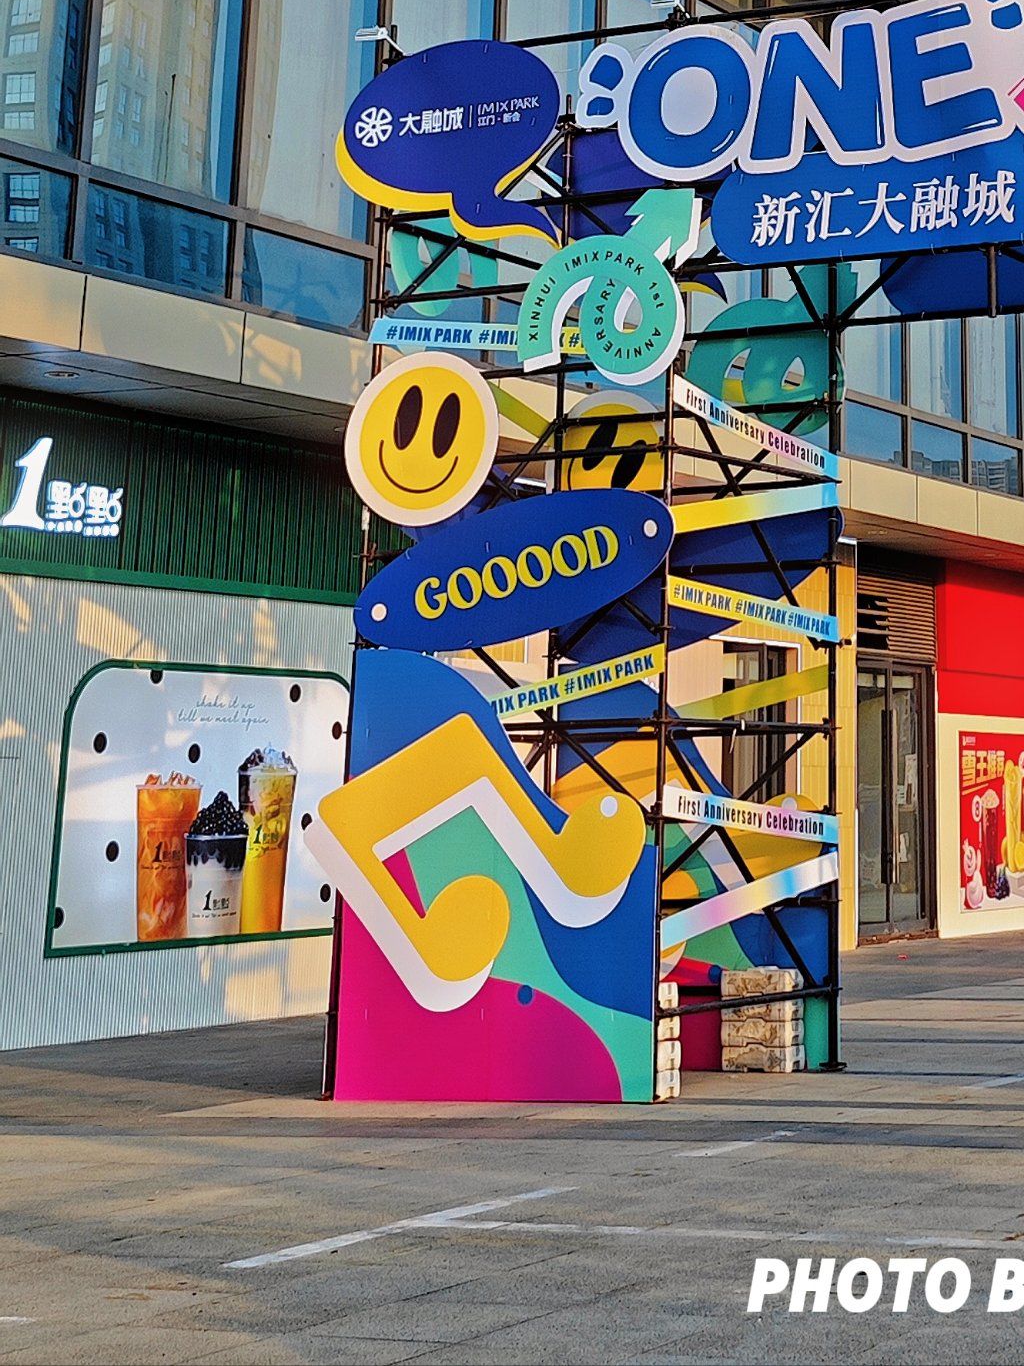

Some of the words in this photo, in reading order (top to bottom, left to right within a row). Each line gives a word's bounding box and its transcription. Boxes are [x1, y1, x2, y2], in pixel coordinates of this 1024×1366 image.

[510, 95, 540, 112] PARK
[628, 0, 1003, 169] ONE
[398, 107, 465, 137] 大融城
[385, 324, 434, 343] #IMIX
[434, 326, 472, 345] PARK
[528, 276, 557, 342] XINHUI
[685, 387, 708, 414] First
[708, 398, 765, 445] Anniversary
[767, 430, 827, 471] Celebration
[413, 524, 620, 620] GOOOOD
[673, 583, 705, 605] #IMIX
[704, 591, 732, 612] PARK
[735, 598, 764, 620] #IMIX
[763, 604, 788, 625] PARK
[810, 616, 831, 636] PARK
[518, 683, 560, 709] PARK
[564, 667, 612, 695] #IMIX
[614, 652, 655, 679] PARK
[677, 794, 702, 817] First
[703, 797, 764, 830] Anniversary
[765, 810, 825, 836] Celebration
